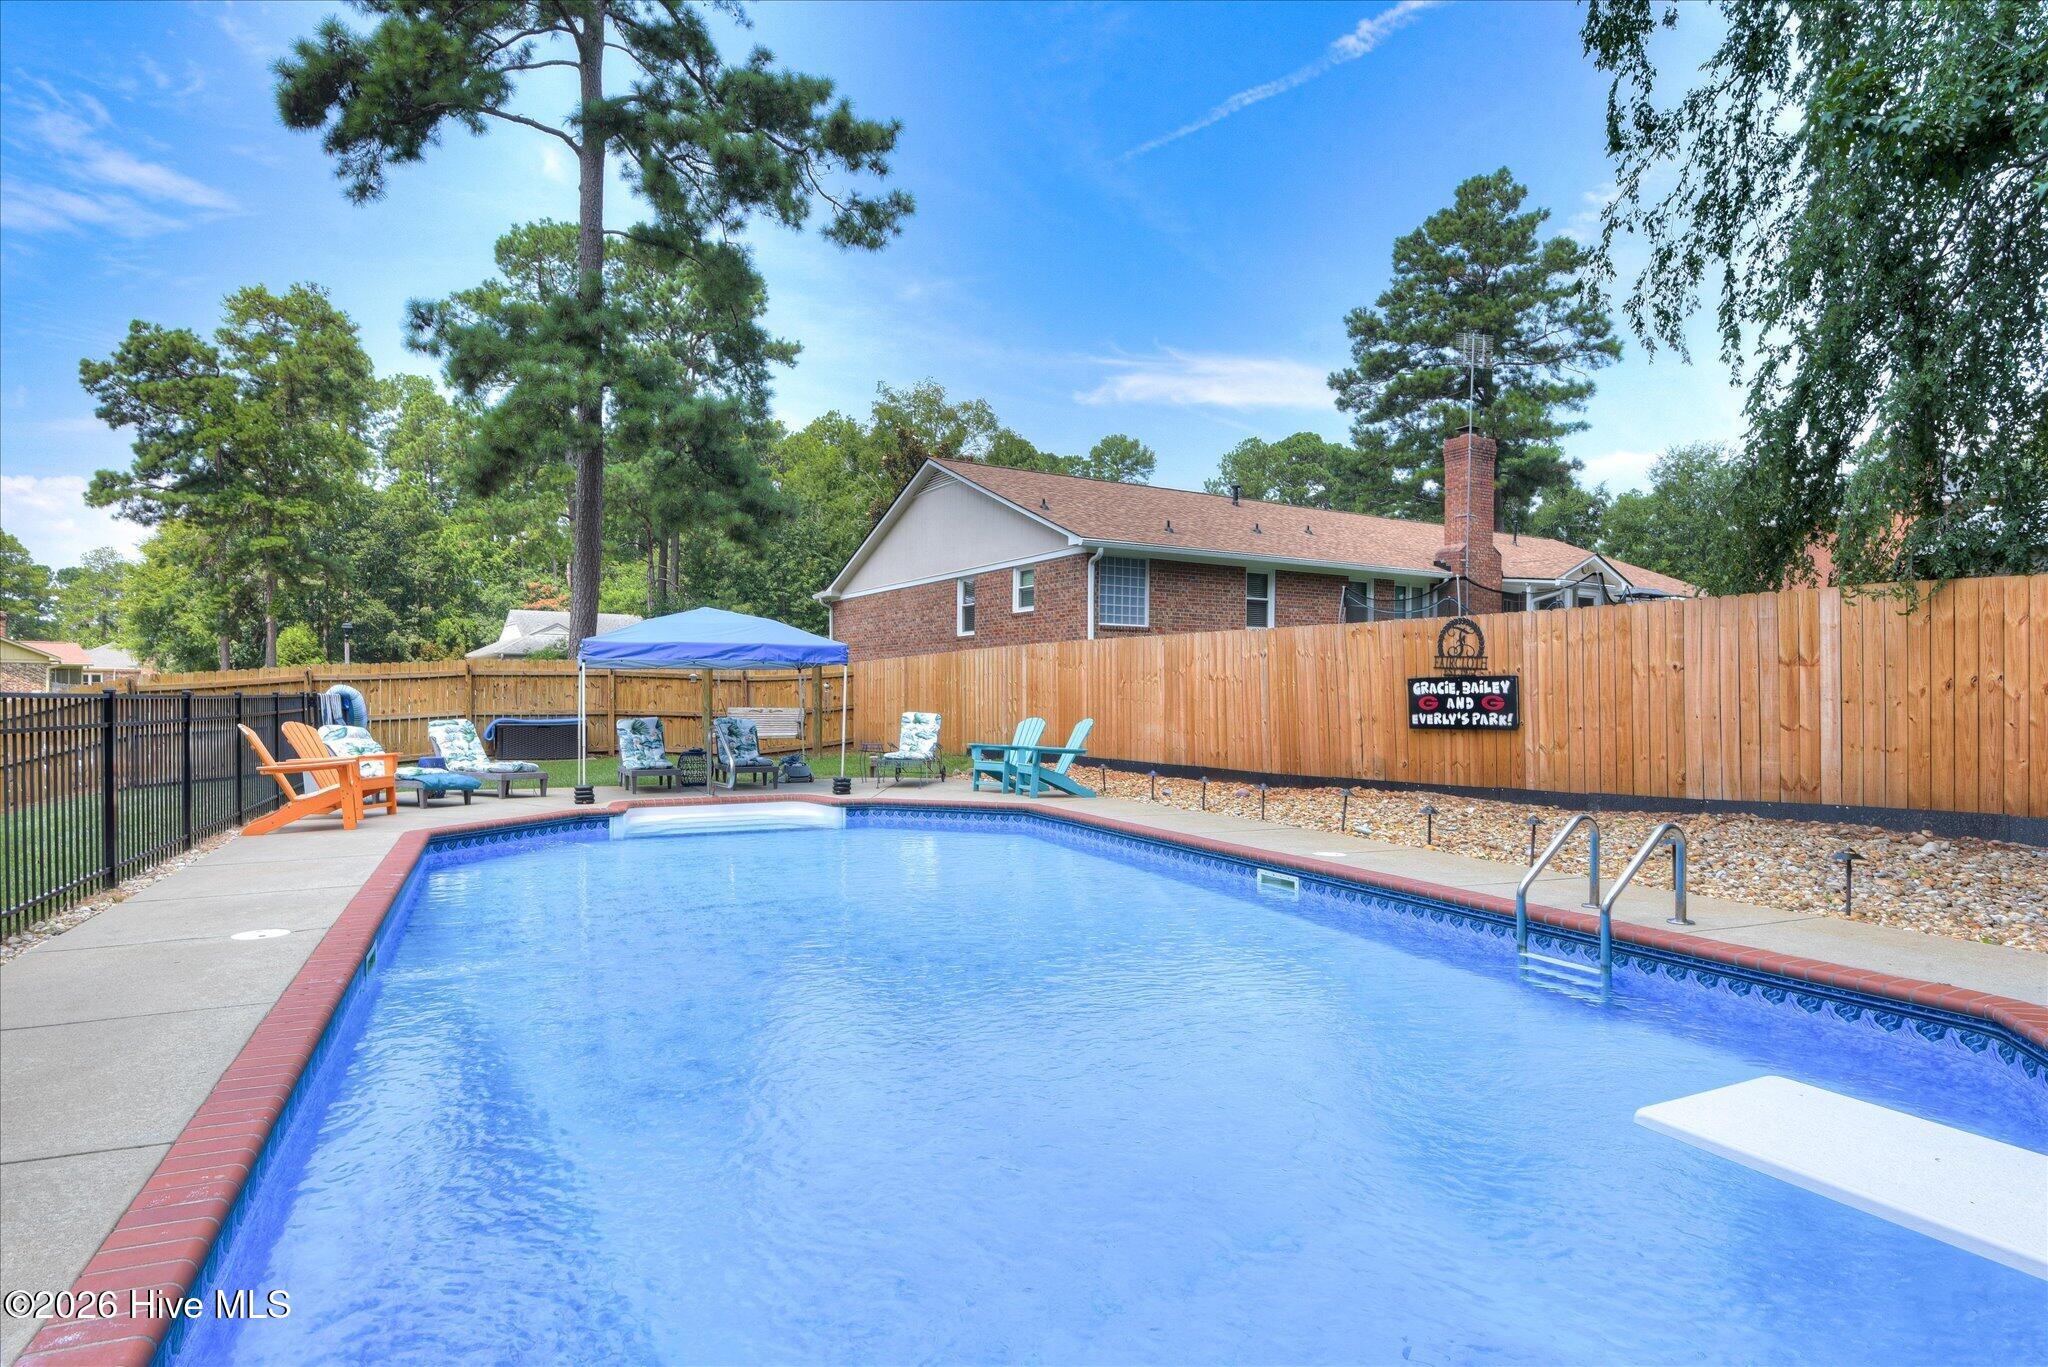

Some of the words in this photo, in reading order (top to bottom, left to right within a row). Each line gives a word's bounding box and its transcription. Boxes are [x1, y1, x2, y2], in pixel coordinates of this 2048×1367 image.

[1446, 697, 1474, 709] AND
[1411, 712, 1470, 726] EVERLY'S
[1471, 713, 1513, 726] PARK!
